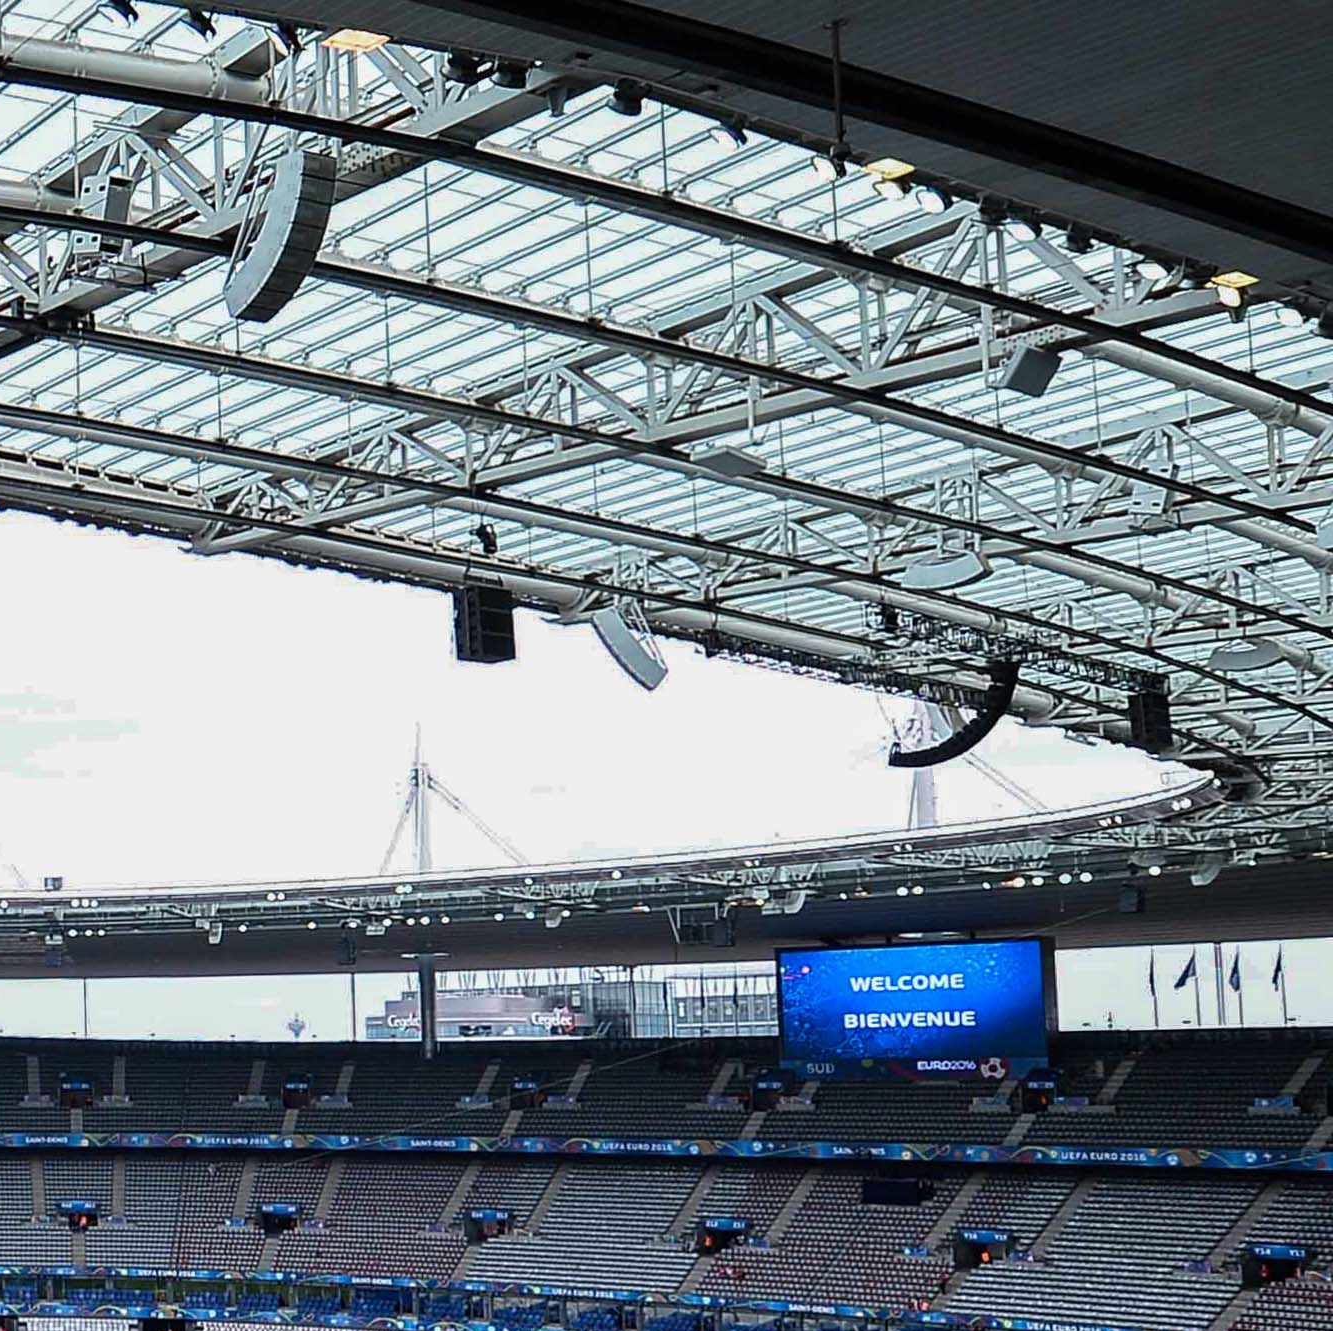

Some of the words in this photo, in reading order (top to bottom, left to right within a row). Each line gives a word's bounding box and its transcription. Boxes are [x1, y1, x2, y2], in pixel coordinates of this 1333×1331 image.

[849, 973, 965, 992] WELCOME
[387, 1013, 421, 1032] Cegele
[530, 1012, 574, 1032] Cegelec
[843, 1010, 977, 1029] BIENVENUE
[806, 1062, 836, 1074] SUD
[916, 1060, 977, 1071] EURO2016
[25, 1136, 68, 1144] SAINT-DENIS
[204, 1137, 226, 1145] UEFA
[226, 1137, 247, 1145] EURO
[248, 1137, 269, 1145] 2016
[410, 1139, 456, 1148] SAINT-DENIS
[602, 1142, 626, 1150] UEFA
[626, 1143, 649, 1151] EURO
[650, 1143, 673, 1151] 2016
[1061, 1152, 1089, 1160] UEFA
[1090, 1152, 1118, 1161] EURO
[1120, 1152, 1147, 1161] 2016
[552, 1287, 573, 1296] UEFA
[573, 1288, 593, 1297] EURO
[595, 1289, 614, 1298] 2016
[788, 1303, 836, 1315] SAINT-DENIS
[1026, 1322, 1051, 1331] UEFA
